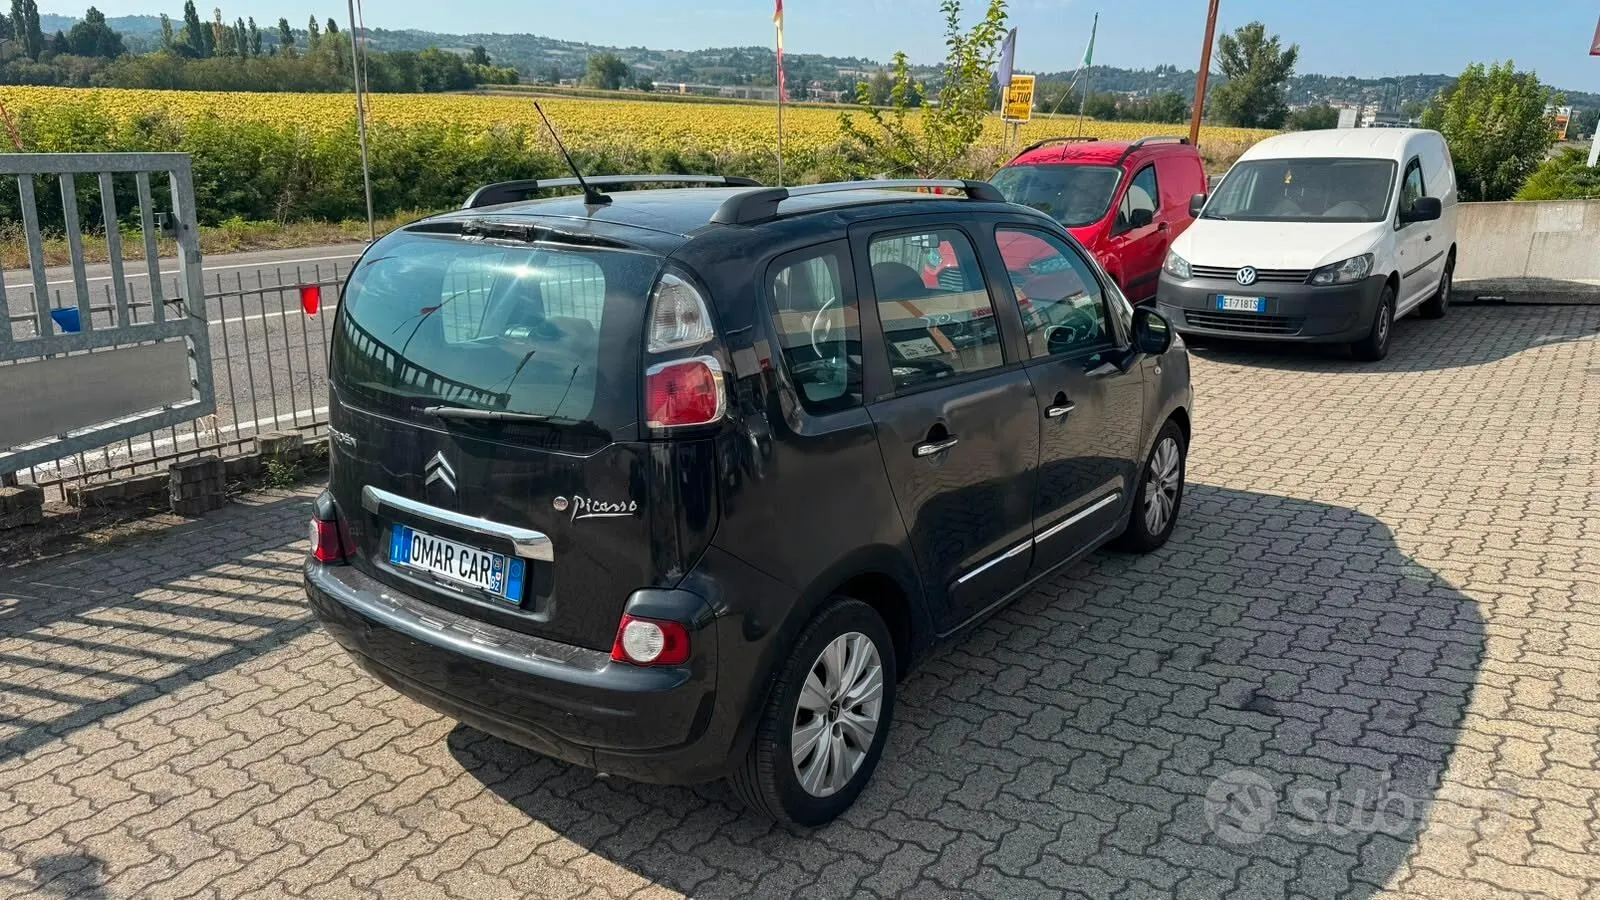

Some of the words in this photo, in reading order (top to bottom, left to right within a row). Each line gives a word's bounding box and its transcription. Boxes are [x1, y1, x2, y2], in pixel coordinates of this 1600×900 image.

[571, 495, 637, 522] Picasso
[412, 535, 454, 573] OMAR
[459, 549, 491, 585] CAR
